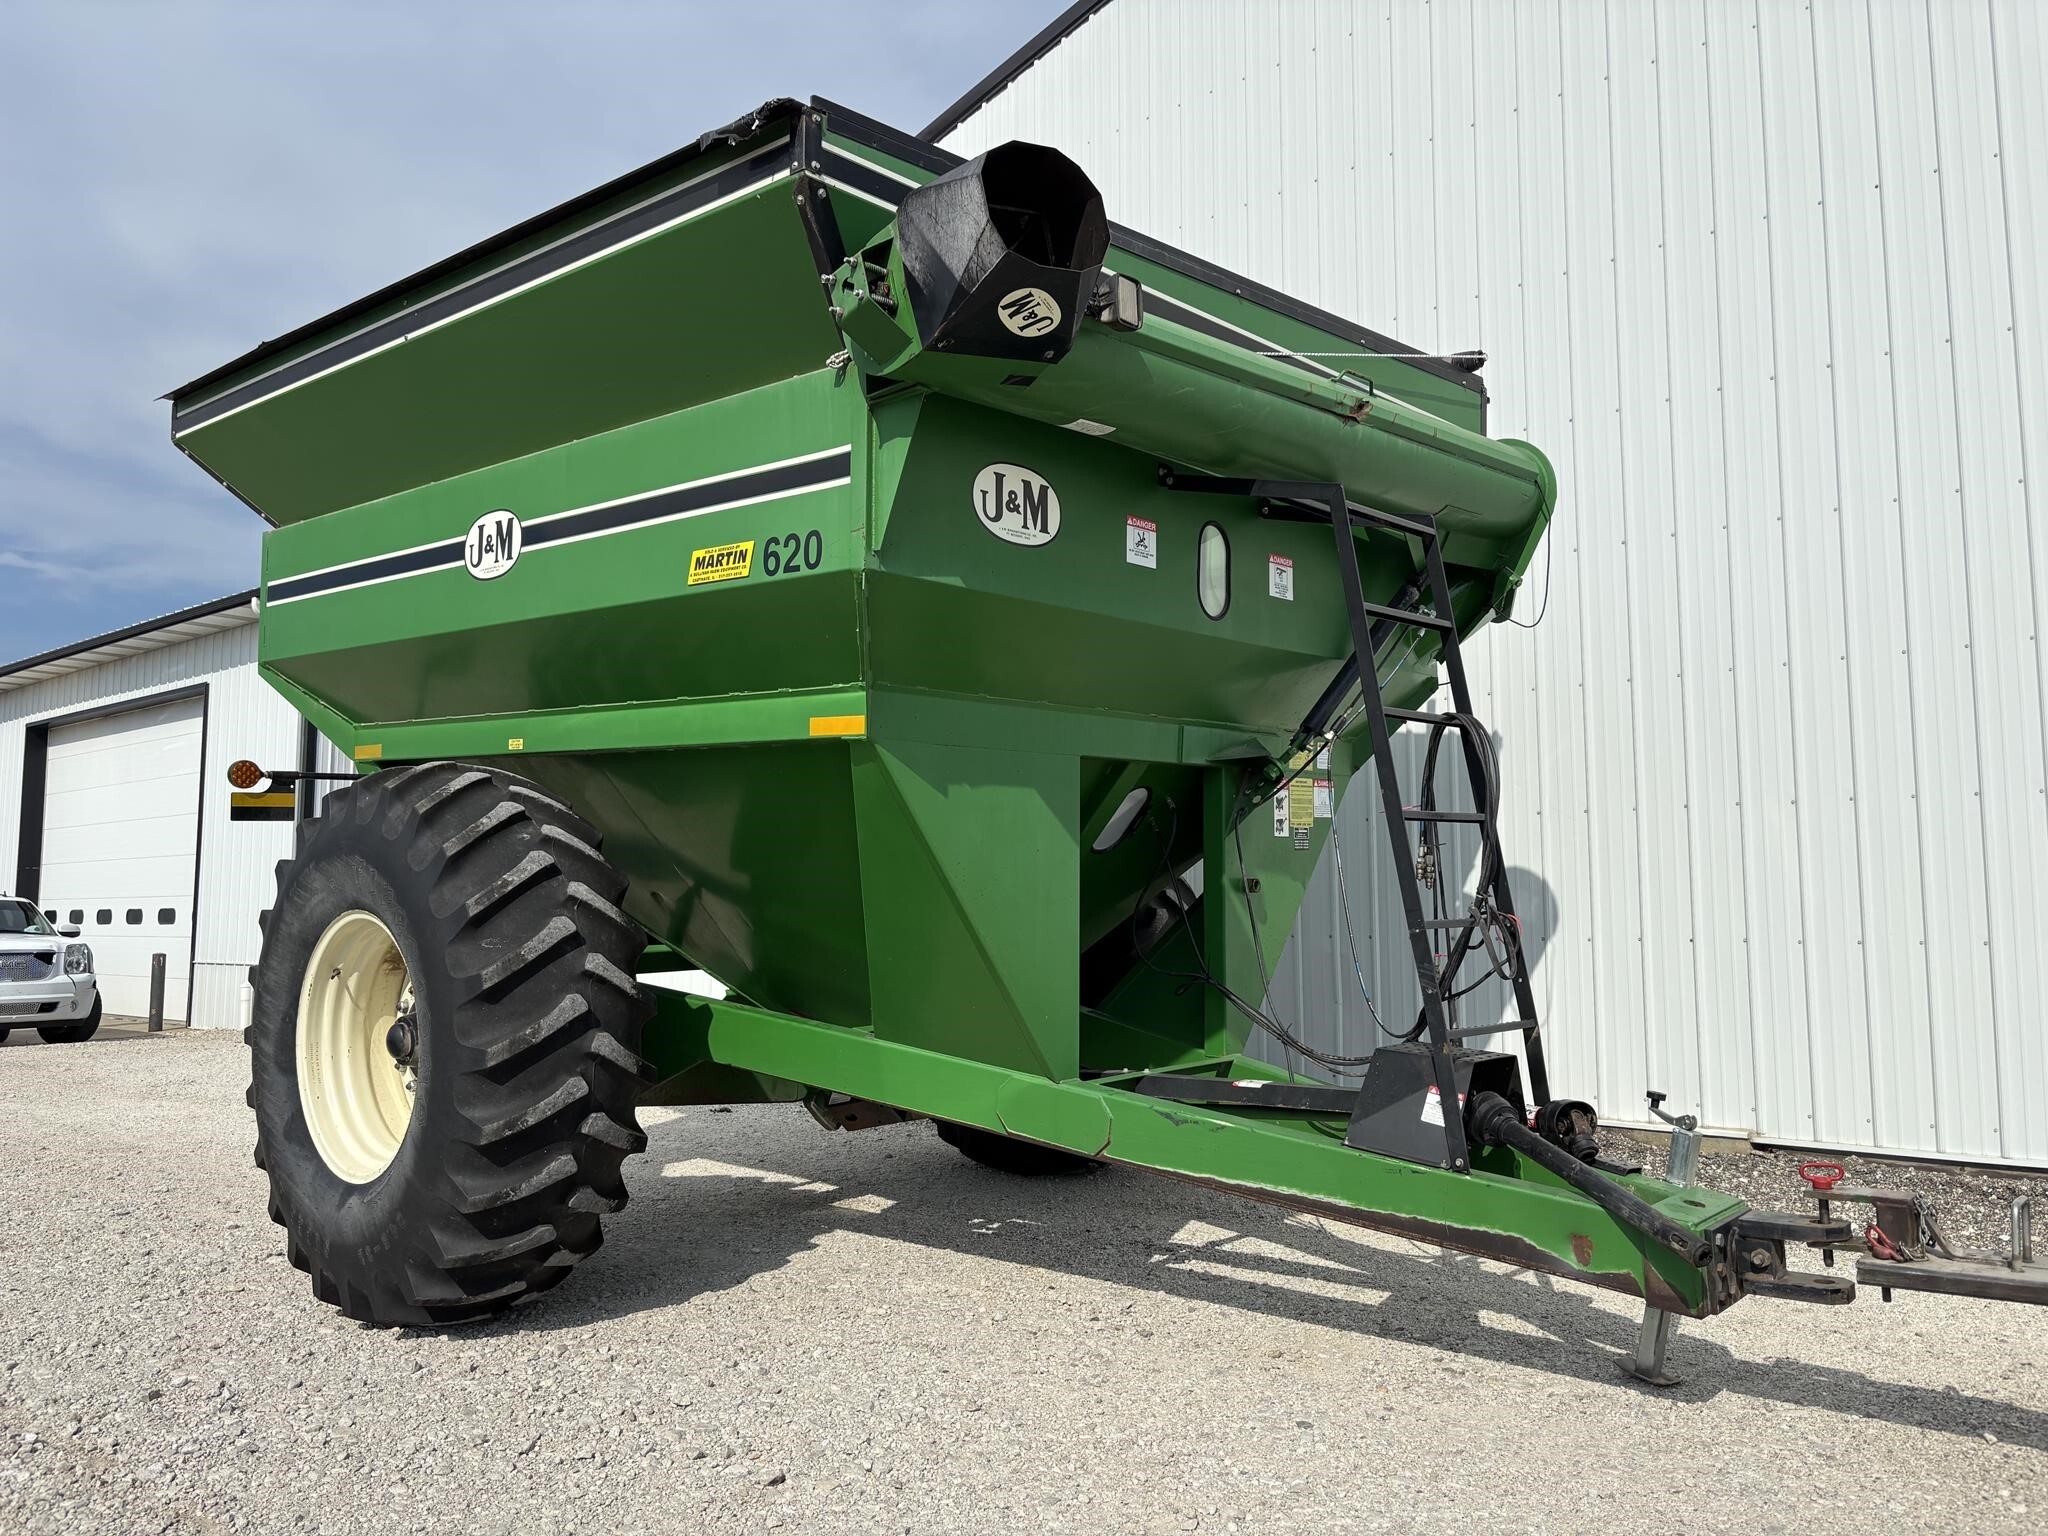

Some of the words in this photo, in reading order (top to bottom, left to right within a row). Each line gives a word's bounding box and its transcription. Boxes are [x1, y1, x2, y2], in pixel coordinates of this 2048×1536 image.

[1000, 291, 1054, 332] J&M
[980, 471, 1050, 535] J&M
[469, 517, 515, 568] J&M
[1132, 518, 1156, 531] DANGER
[694, 548, 748, 571] MARTIN
[763, 529, 823, 577] 620
[0, 960, 26, 968] MC
